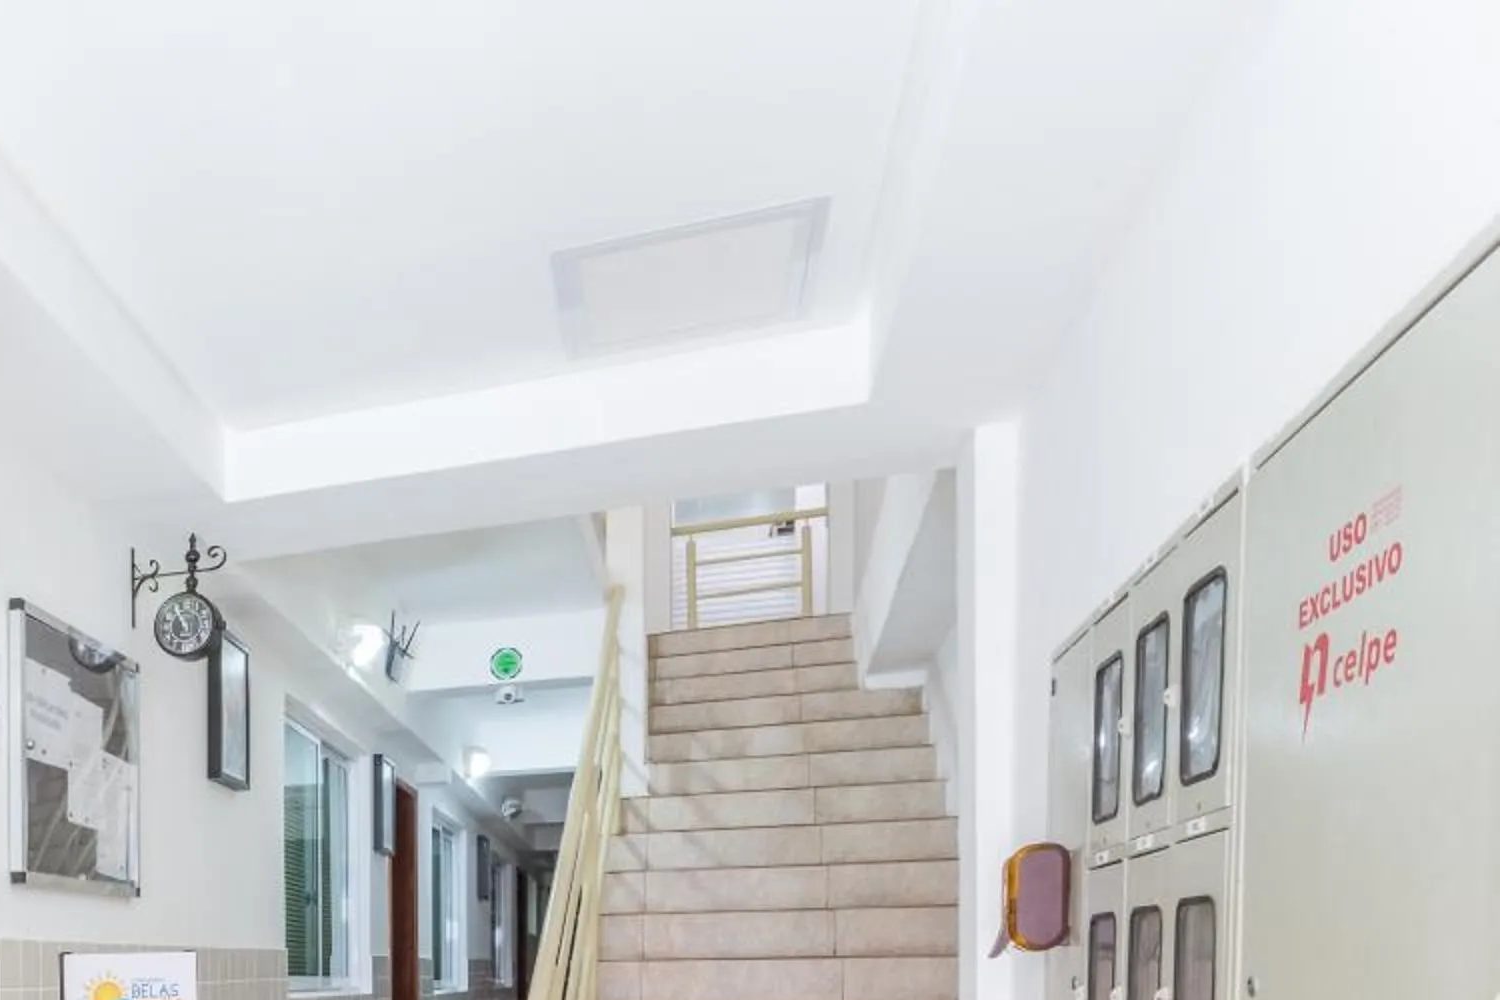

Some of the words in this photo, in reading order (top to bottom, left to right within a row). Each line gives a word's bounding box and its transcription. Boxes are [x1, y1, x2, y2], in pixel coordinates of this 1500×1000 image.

[1329, 513, 1367, 562] USO
[1299, 542, 1402, 630] EXCLUSIVO
[1332, 629, 1397, 686] celpe
[131, 983, 180, 998] BELAS
